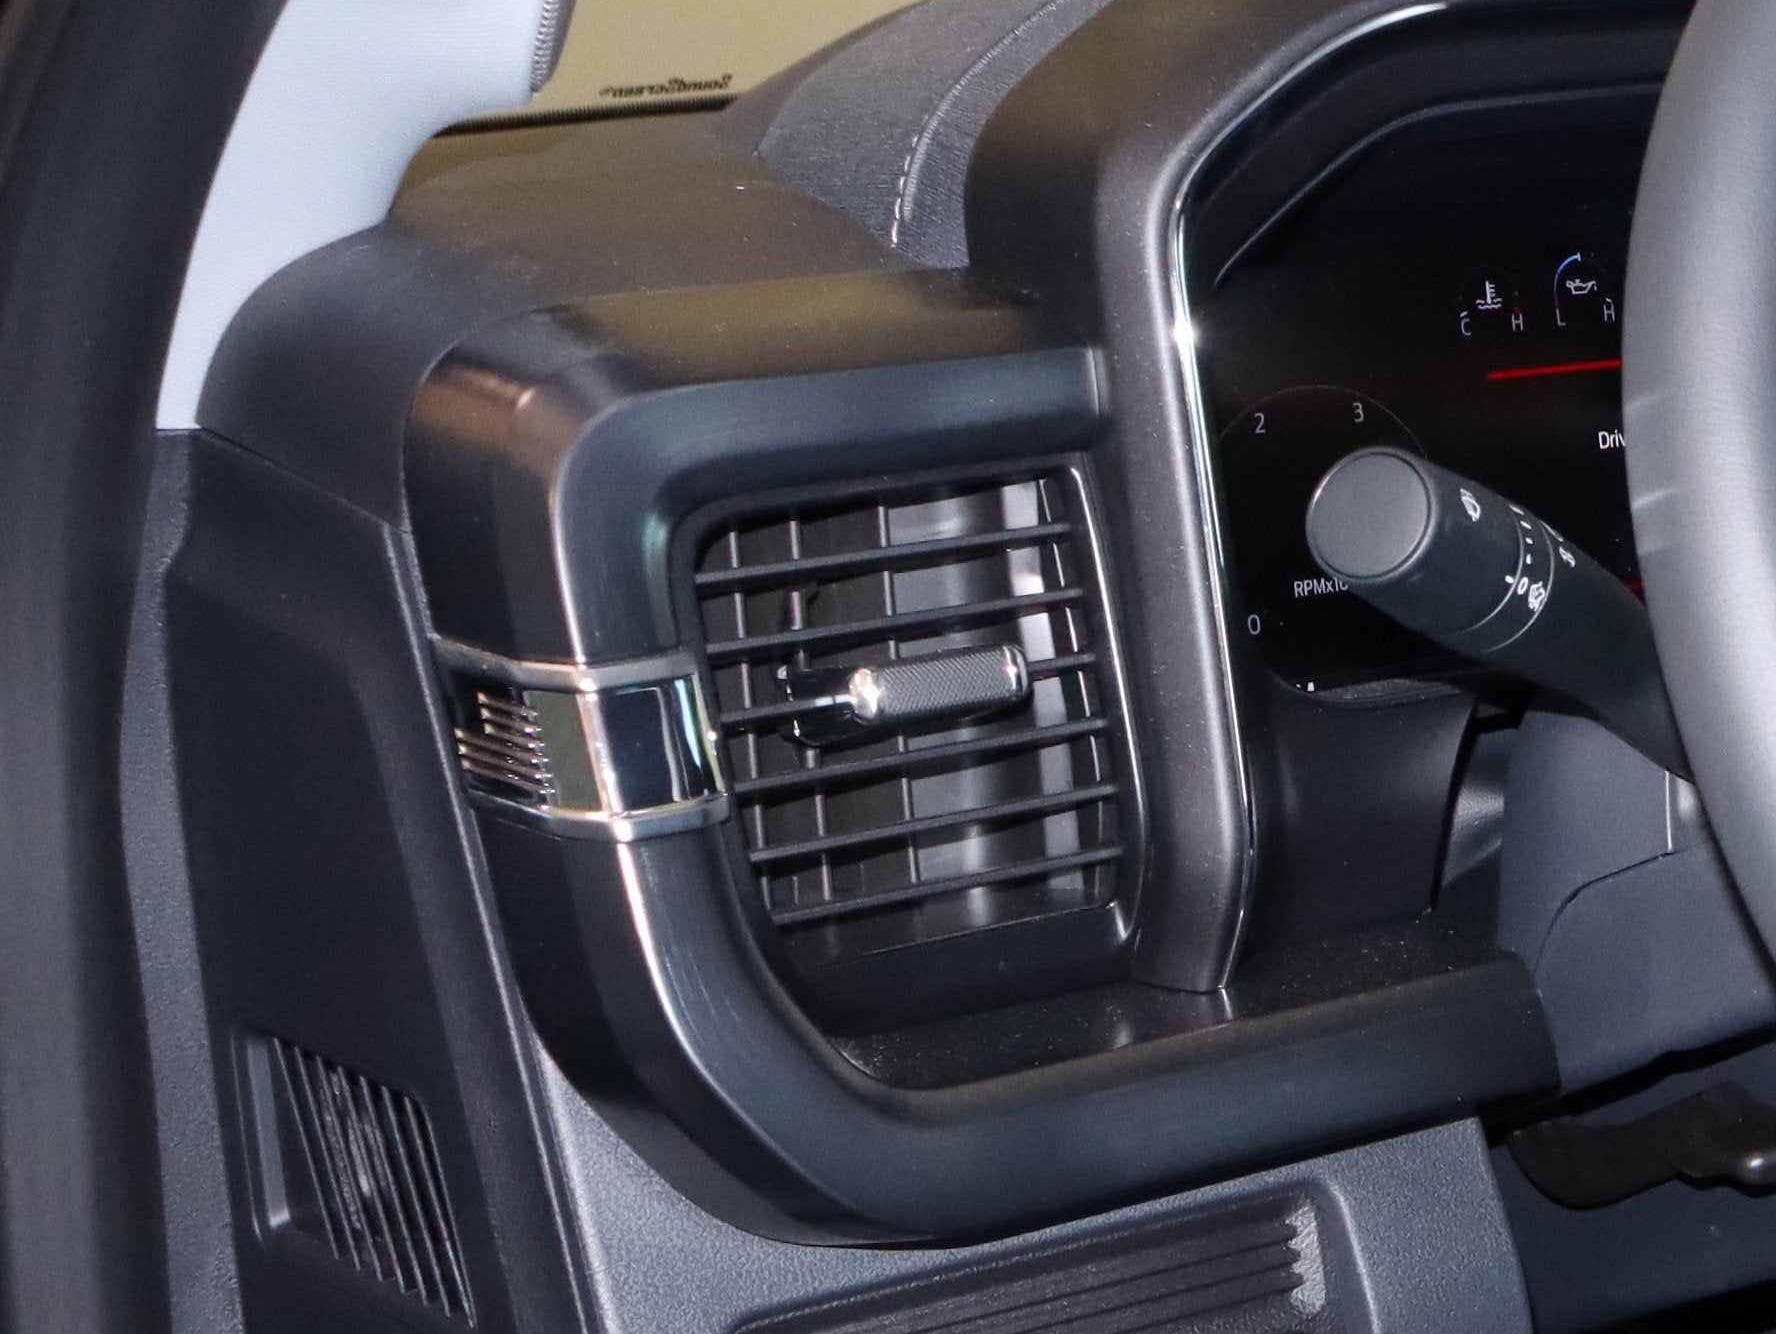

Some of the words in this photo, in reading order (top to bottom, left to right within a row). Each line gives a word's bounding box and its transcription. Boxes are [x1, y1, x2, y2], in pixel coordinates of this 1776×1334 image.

[1253, 412, 1266, 435] 2
[1352, 402, 1365, 423] 3
[1247, 614, 1261, 636] 0
